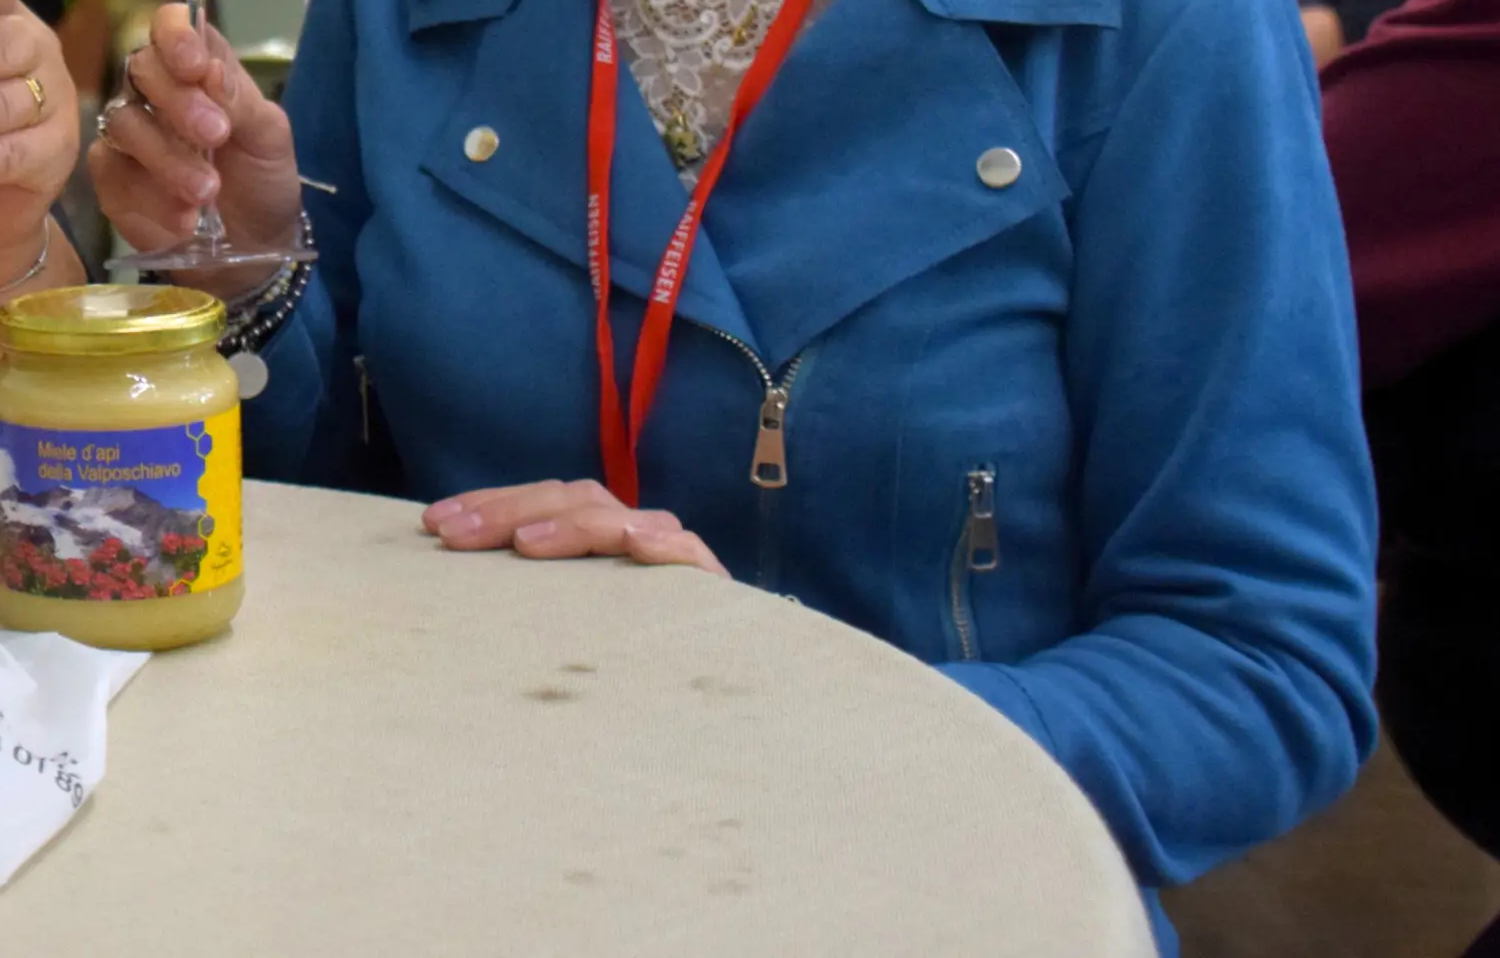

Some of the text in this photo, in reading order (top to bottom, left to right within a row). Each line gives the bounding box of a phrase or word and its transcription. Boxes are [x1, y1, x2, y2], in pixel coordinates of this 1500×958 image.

[654, 199, 698, 304] RAIFFEISEN
[37, 441, 120, 465] Miele d'api
[38, 463, 182, 485] della Valposchiavo
